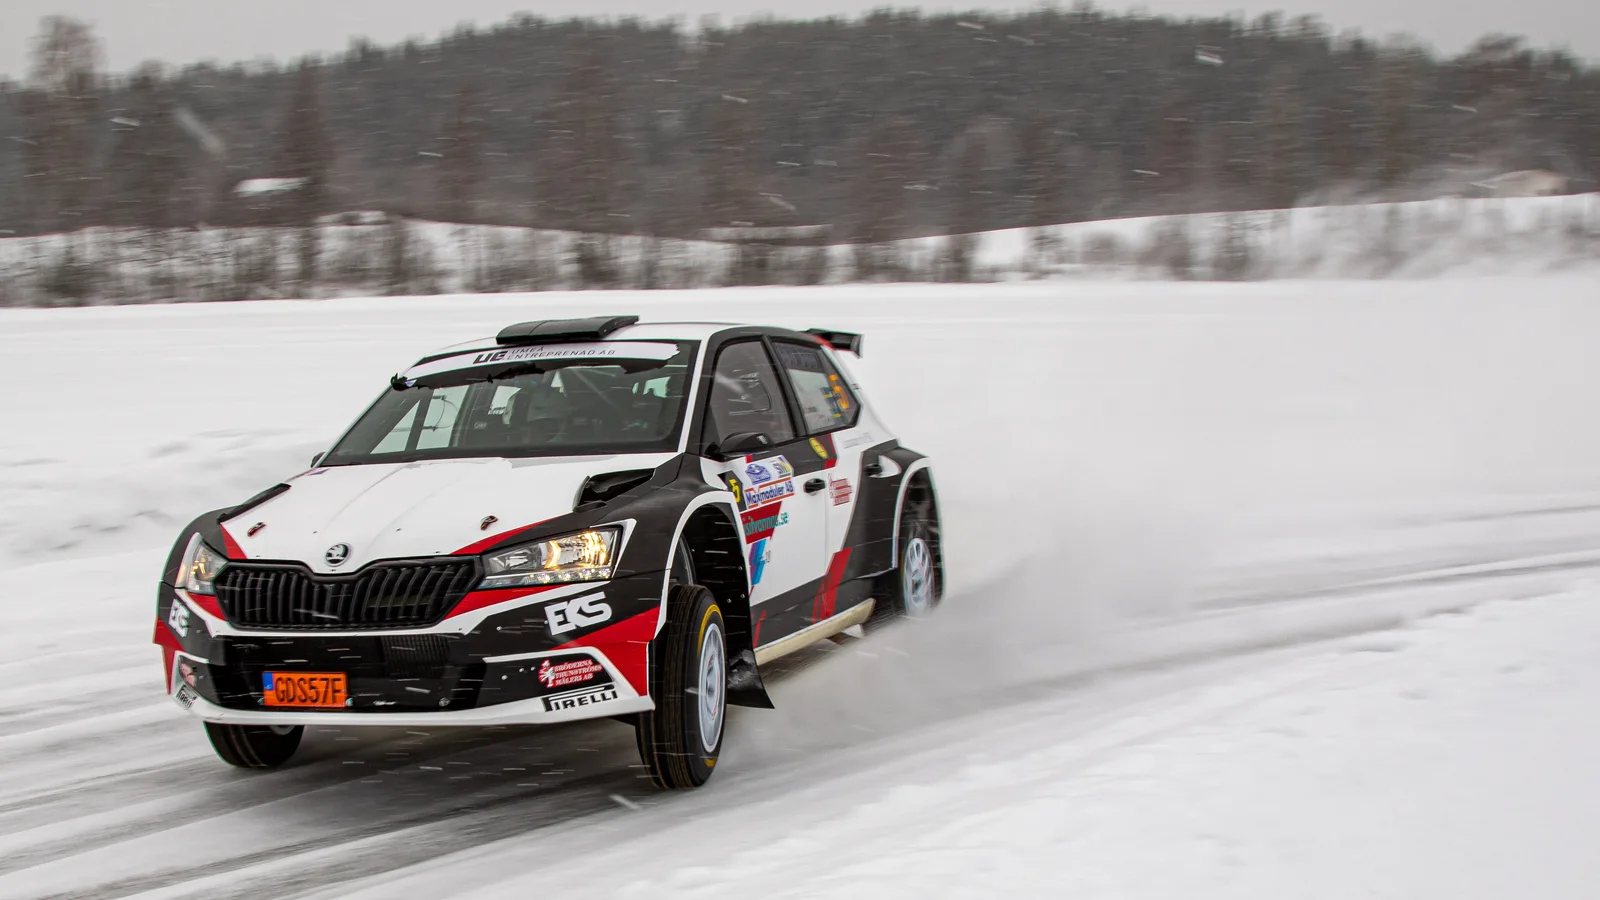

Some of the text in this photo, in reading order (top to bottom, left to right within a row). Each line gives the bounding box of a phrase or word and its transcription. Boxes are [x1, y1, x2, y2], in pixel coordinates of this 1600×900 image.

[507, 350, 596, 360] ENTREPRENAD
[828, 374, 850, 410] 5
[729, 478, 741, 503] 5
[745, 480, 795, 505] Maxmoduler AB
[544, 591, 613, 636] EKS
[554, 660, 593, 672] BRÖDERNA
[583, 672, 594, 682] AB
[275, 676, 342, 704] GDS57F
[541, 683, 618, 713] PIRELLI
